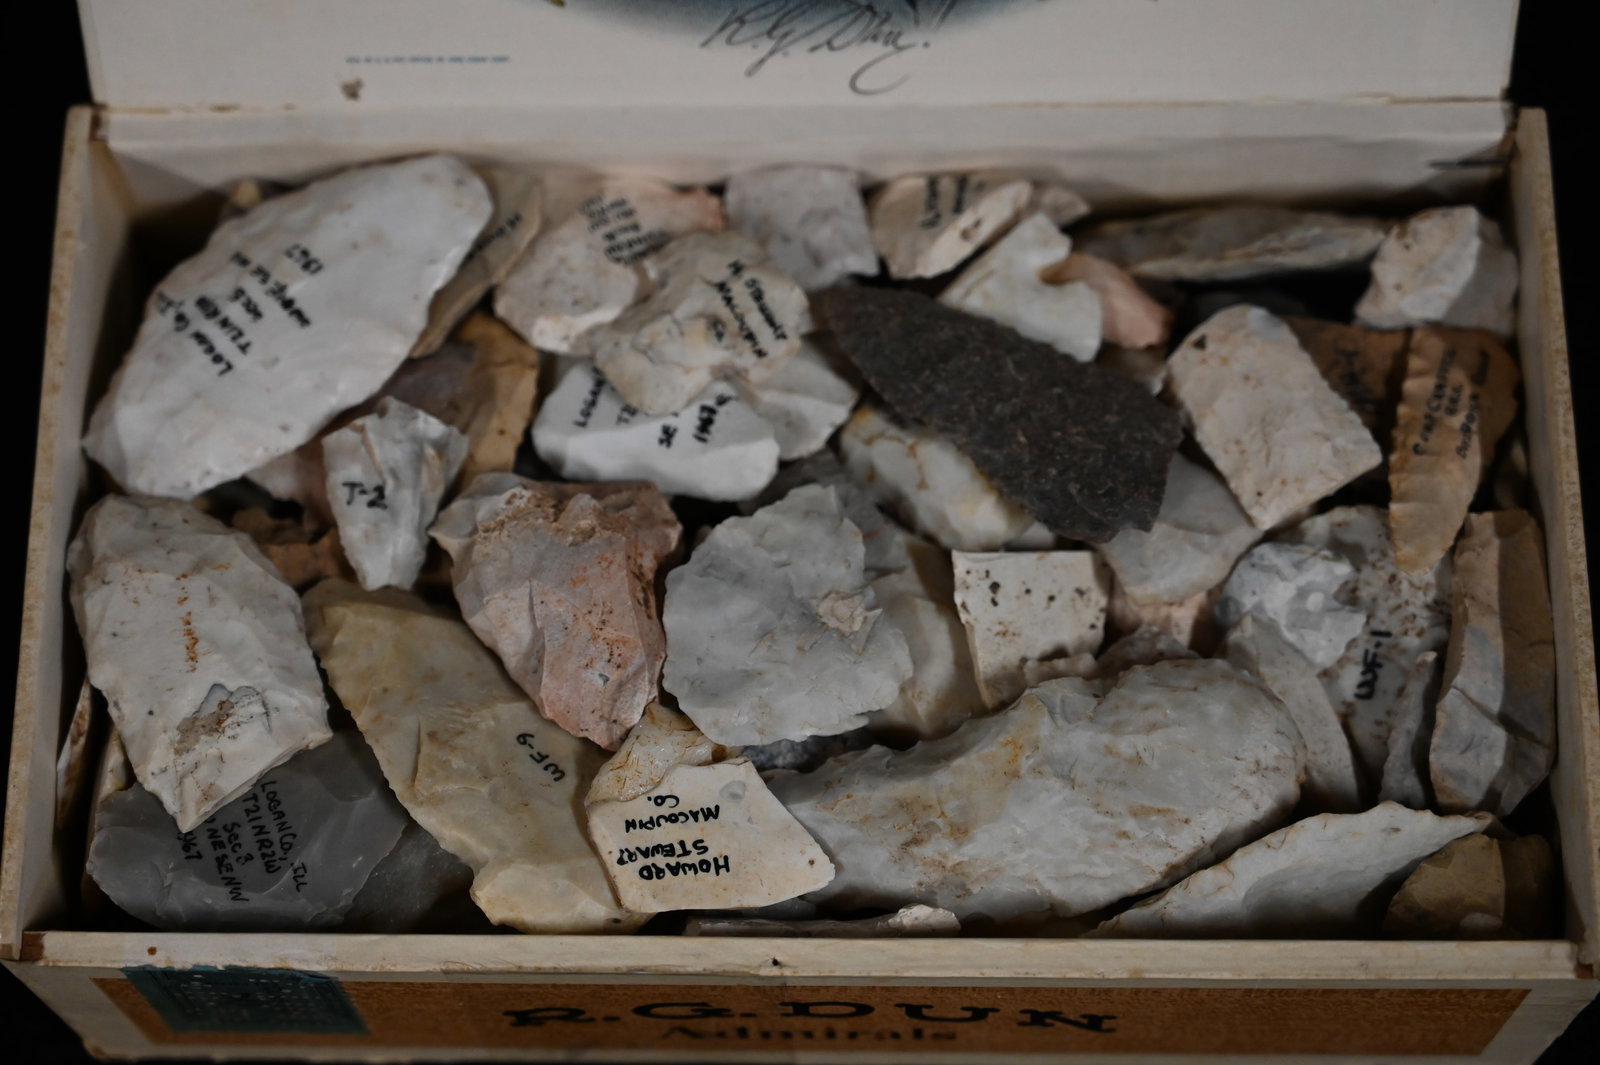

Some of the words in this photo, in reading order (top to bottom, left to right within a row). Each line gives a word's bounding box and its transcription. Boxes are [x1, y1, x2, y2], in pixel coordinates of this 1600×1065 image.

[341, 480, 388, 511] T-2
[646, 793, 680, 809] CO.
[624, 804, 721, 834] MACOUPIN
[616, 838, 709, 866] STEWART
[638, 854, 731, 881] HOWARD
[660, 1025, 959, 1042] Admirals
